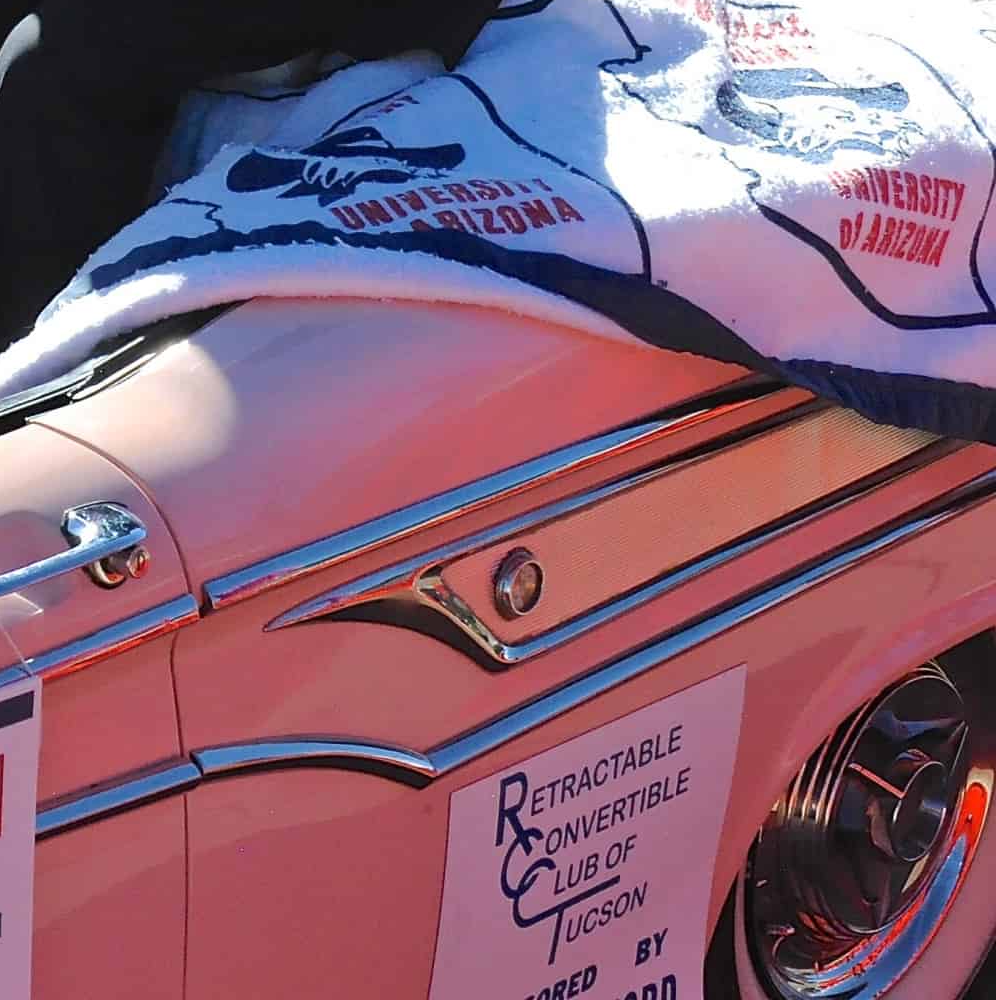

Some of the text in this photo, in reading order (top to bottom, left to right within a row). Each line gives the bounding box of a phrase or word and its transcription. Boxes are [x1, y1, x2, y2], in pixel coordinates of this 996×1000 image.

[828, 168, 965, 221] UNIVERSITY
[861, 213, 950, 268] ARIZONA
[495, 725, 683, 856] RETRACTABLE
[501, 767, 691, 899] CONVERTIBLE
[605, 834, 638, 870] OF
[547, 875, 648, 966] TUCSON
[635, 927, 669, 967] BY
